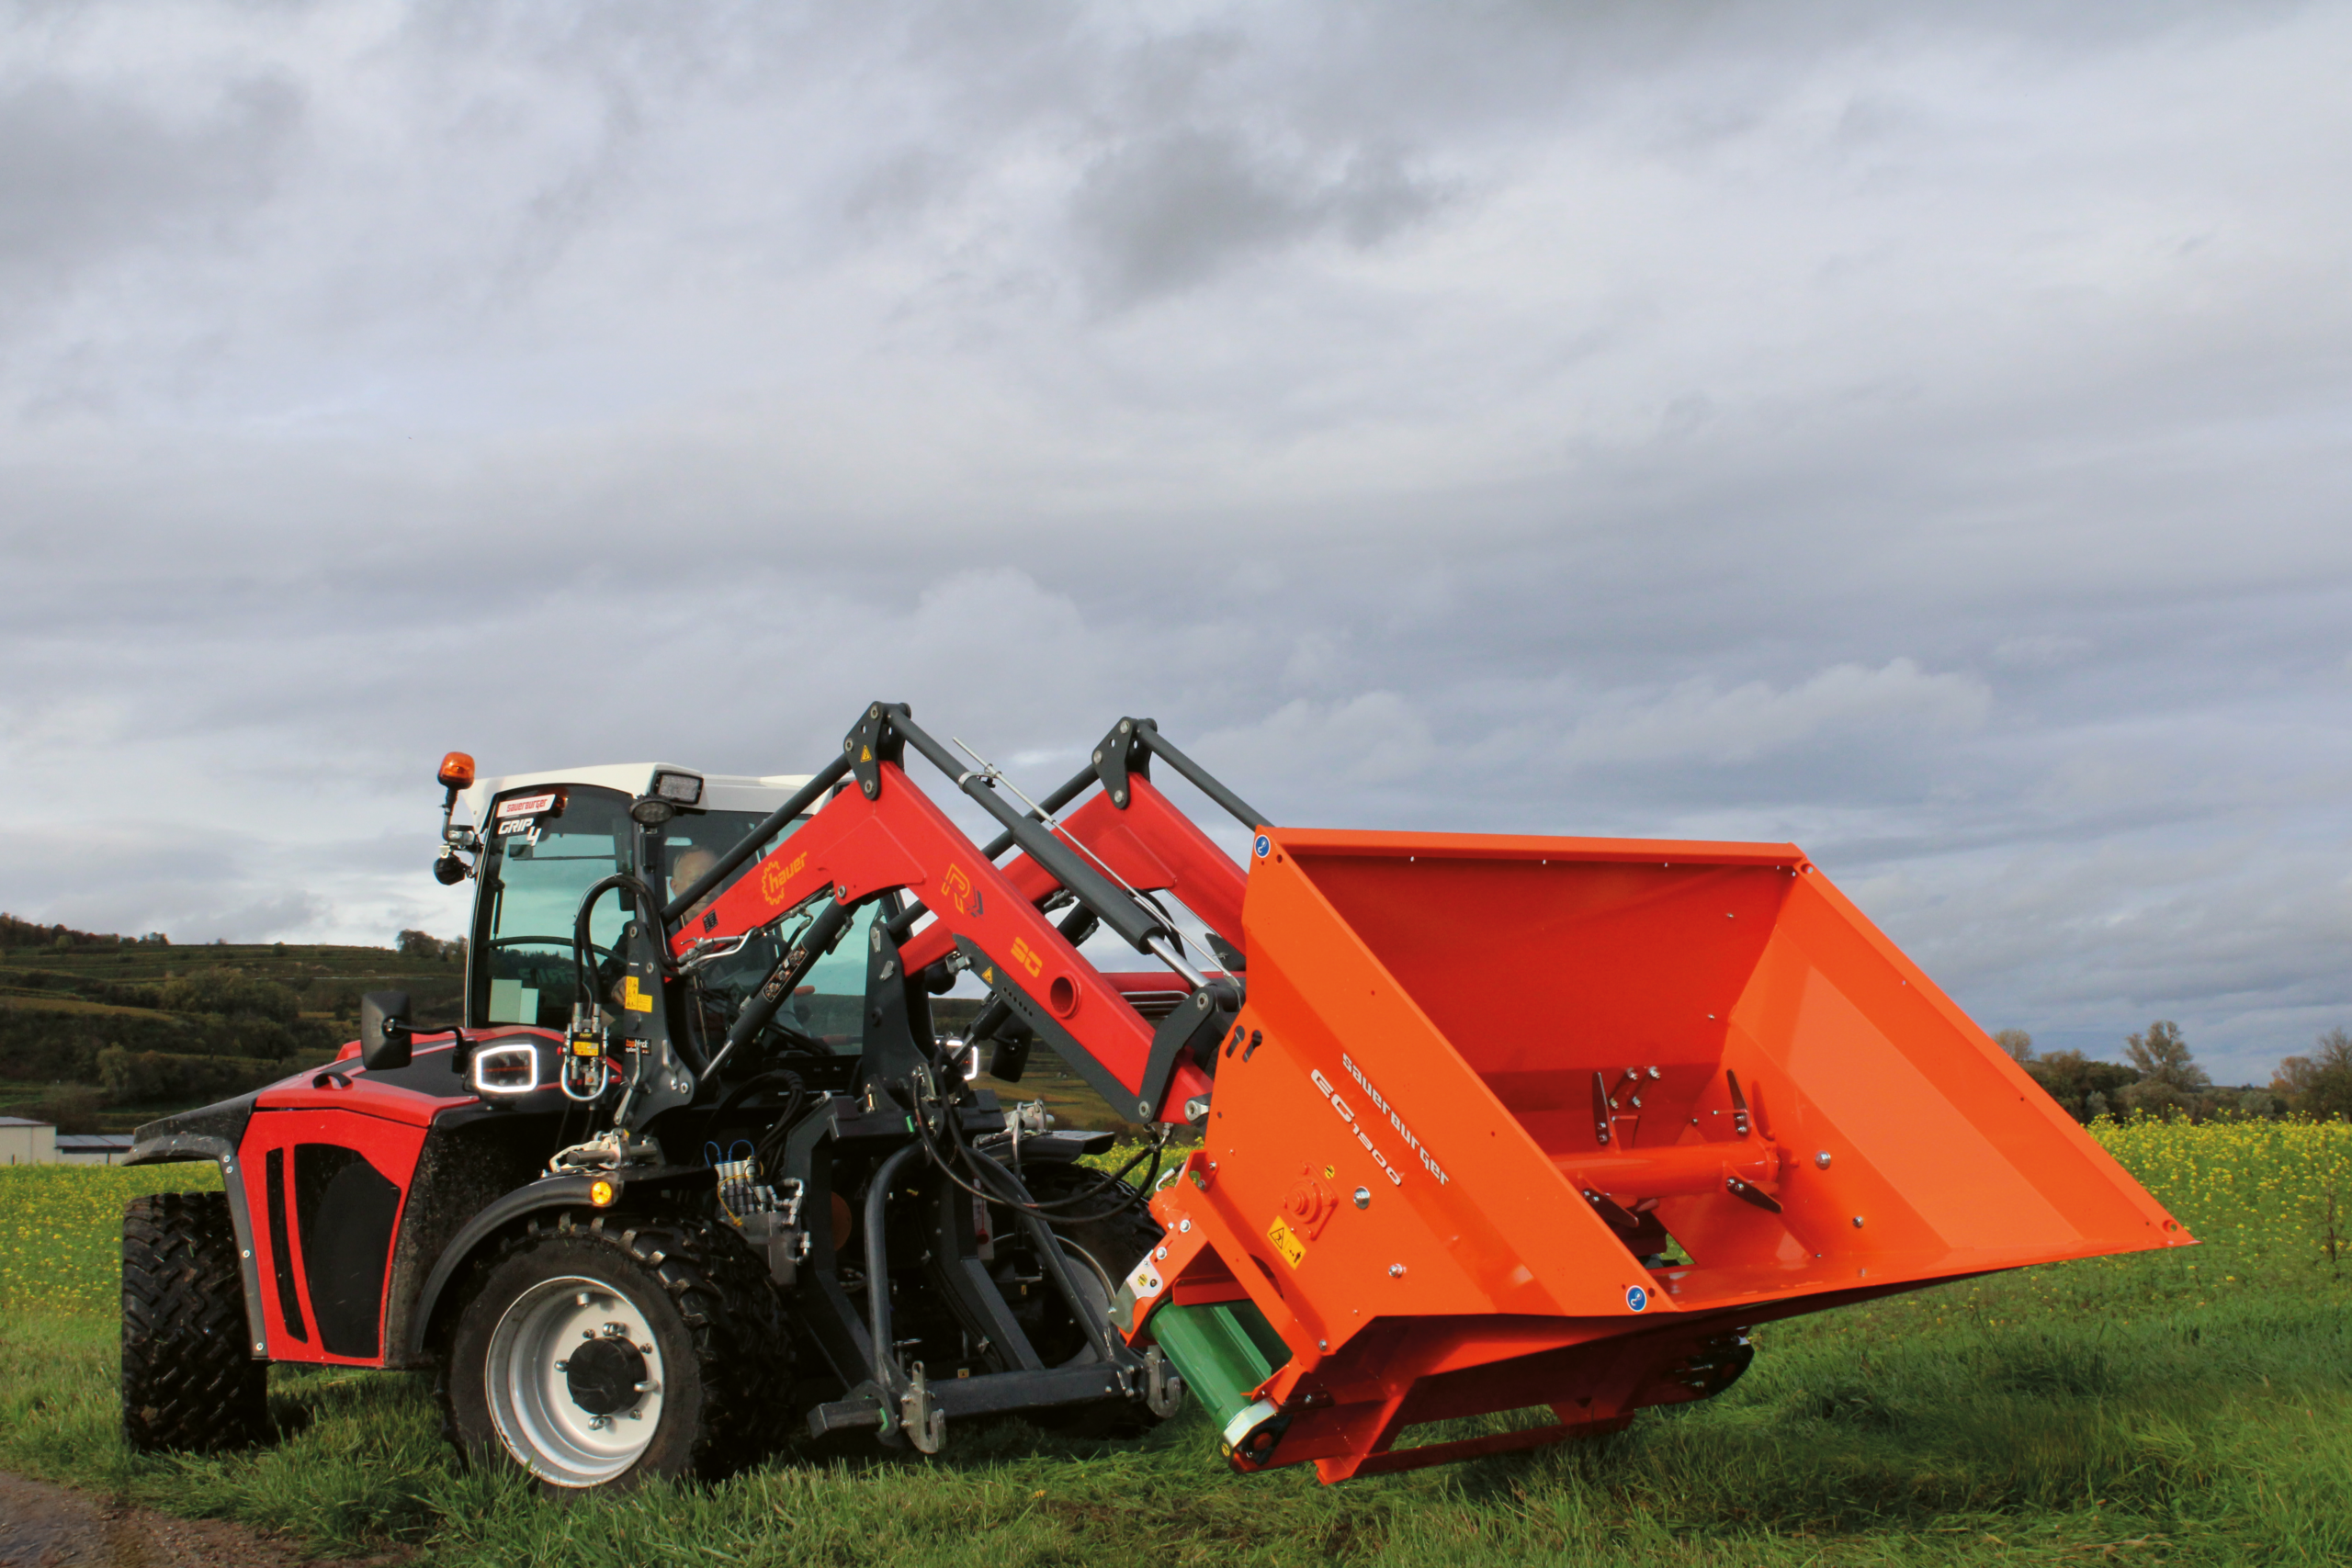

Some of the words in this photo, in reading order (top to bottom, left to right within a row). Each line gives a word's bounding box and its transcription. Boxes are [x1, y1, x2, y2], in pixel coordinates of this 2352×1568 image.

[498, 818, 535, 834] GRIP
[526, 826, 543, 847] 4
[768, 851, 808, 894] hauer
